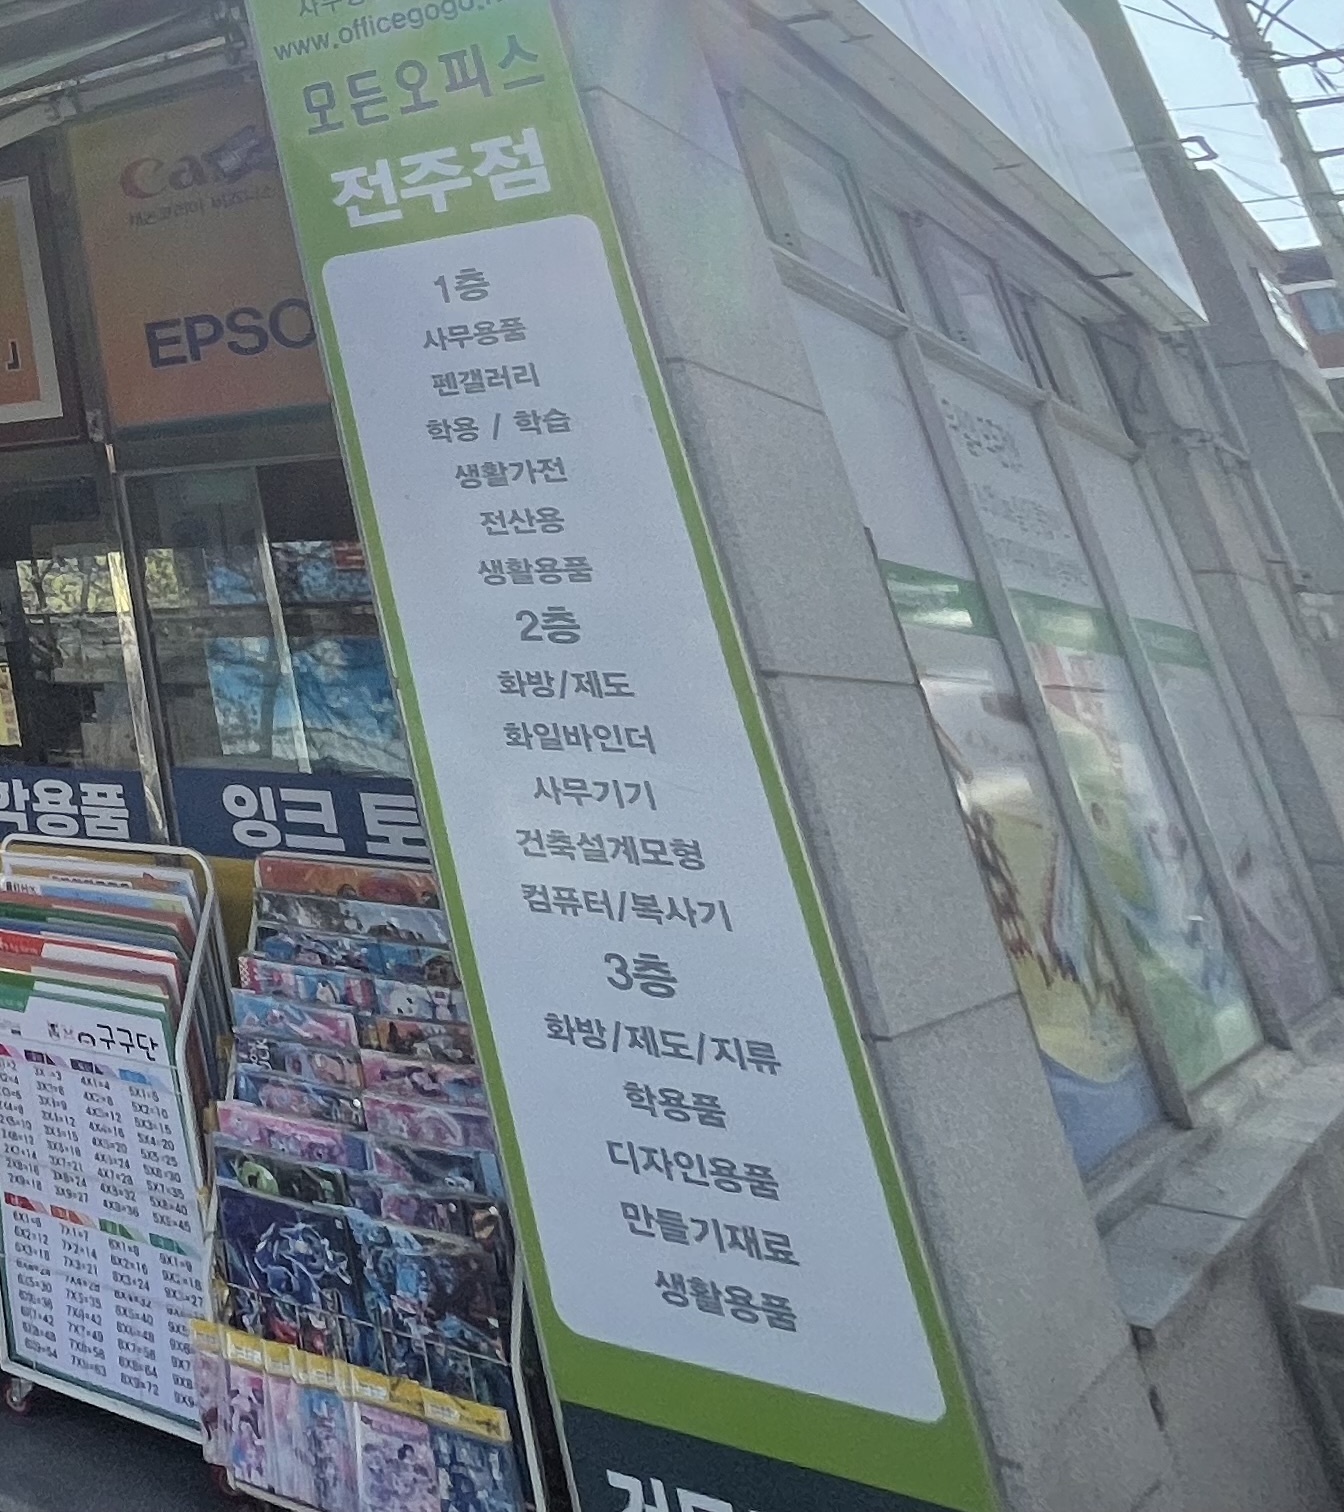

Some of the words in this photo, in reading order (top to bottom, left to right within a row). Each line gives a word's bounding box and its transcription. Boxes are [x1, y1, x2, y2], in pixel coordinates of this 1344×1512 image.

[301, 31, 548, 138] 모든오피스
[330, 125, 553, 230] 전주점
[432, 266, 491, 305] 1층
[422, 315, 528, 352] 사무용품
[430, 361, 541, 398] 펜갤러리
[425, 415, 480, 444] 학용
[512, 406, 572, 437] 학습
[454, 455, 569, 490] 생활가전
[479, 506, 566, 537] 전산용
[477, 555, 594, 587] 생활용품
[514, 604, 582, 645] 2층
[497, 667, 637, 701] 화방/제도
[502, 720, 657, 757] 화일바인더
[531, 773, 657, 811] 사무기기
[221, 783, 347, 853] 잉크
[513, 827, 707, 873] 건축설계모형
[519, 882, 734, 934] 컴퓨터/복사기
[602, 950, 679, 1001] 3층
[545, 1009, 782, 1077] 화방/제도/지류
[622, 1079, 728, 1131] 학용품
[605, 1137, 782, 1202] 디자인용품
[619, 1198, 801, 1269] 만들기재료
[652, 1266, 799, 1334] 생활용품
